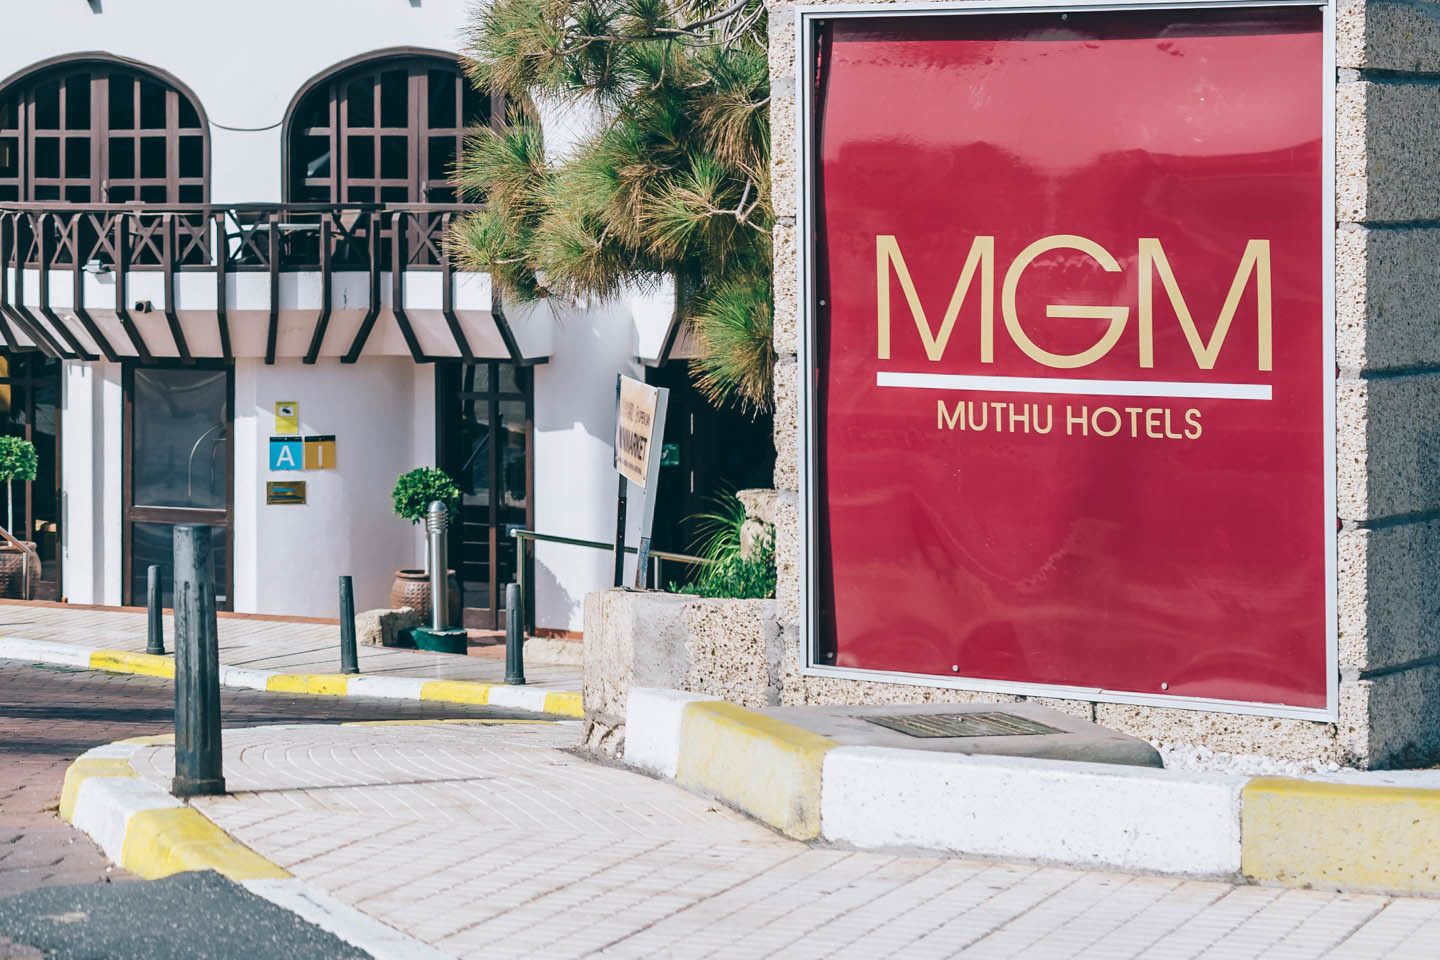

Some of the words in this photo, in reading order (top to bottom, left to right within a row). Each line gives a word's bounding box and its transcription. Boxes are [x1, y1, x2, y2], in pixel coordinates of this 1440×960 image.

[876, 234, 1273, 371] MGM
[936, 400, 1053, 434] MUTHU
[1066, 406, 1203, 440] HOTELS
[276, 445, 295, 467] A
